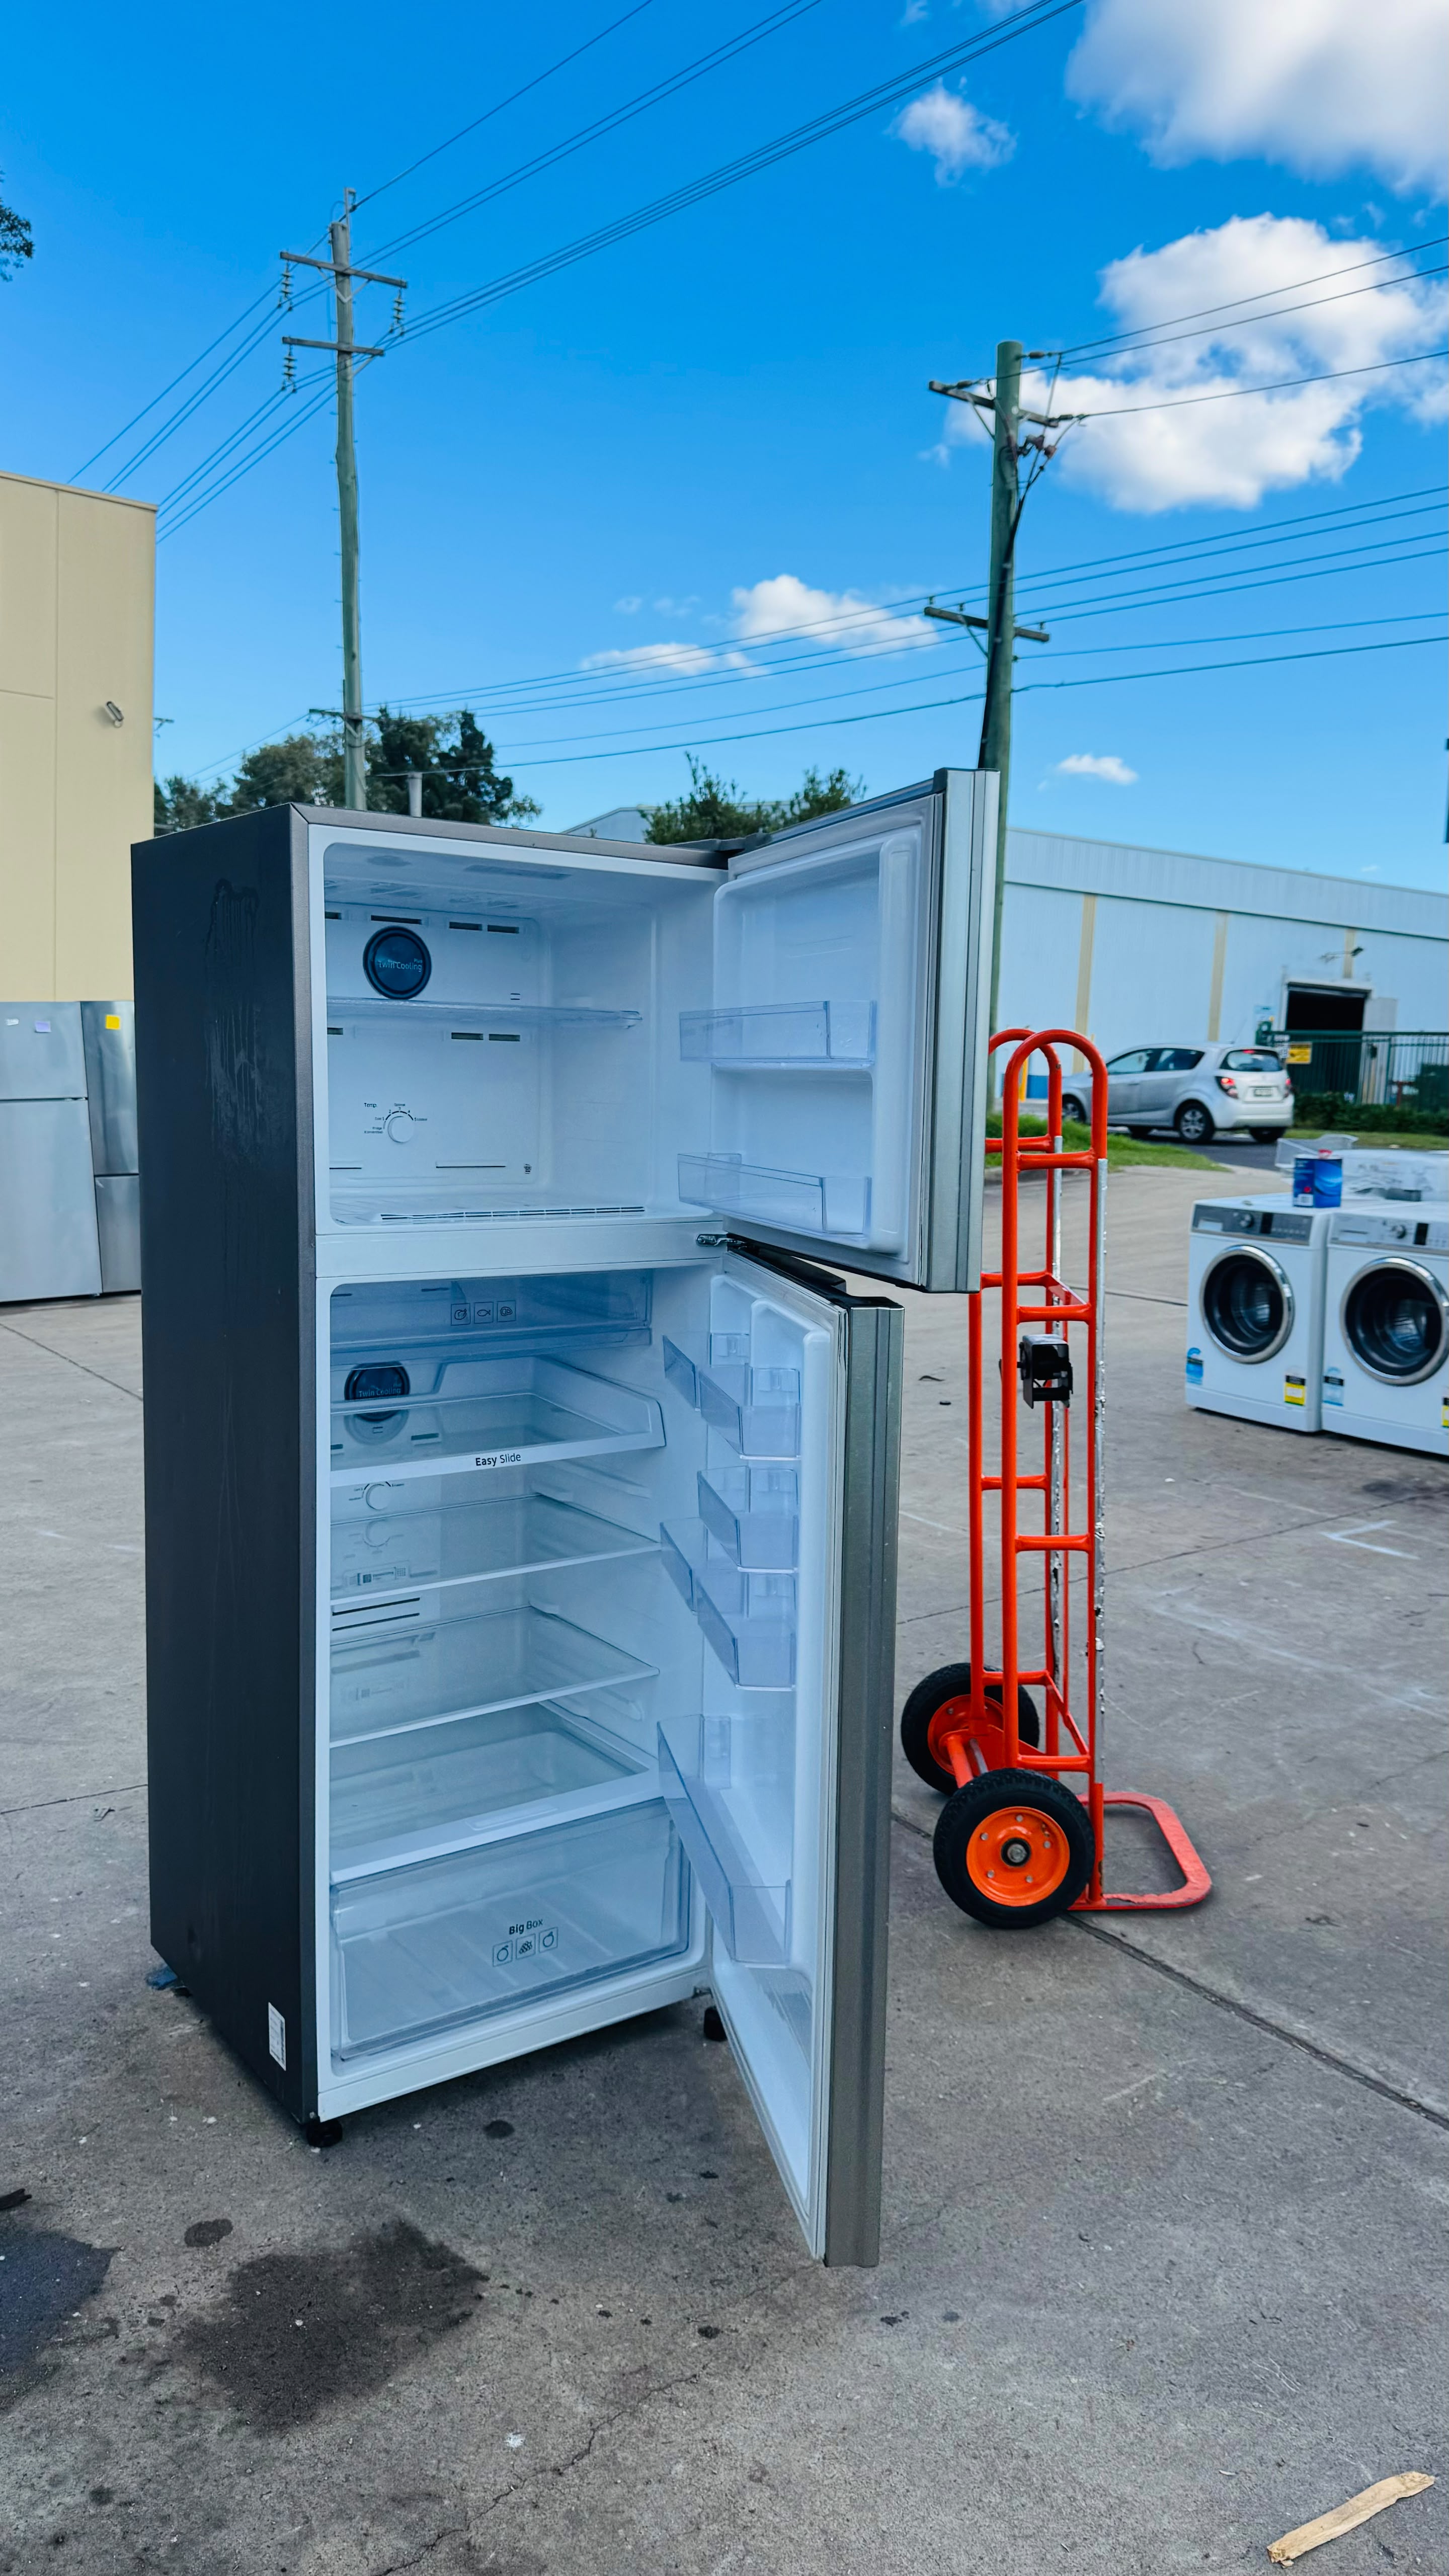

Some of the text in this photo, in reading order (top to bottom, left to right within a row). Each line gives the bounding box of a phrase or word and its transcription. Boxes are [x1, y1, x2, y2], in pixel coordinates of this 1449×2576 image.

[378, 959, 423, 972] Twin Cooling
[359, 1389, 375, 1397] Twin
[475, 1453, 521, 1467] Easy Slide
[509, 1919, 543, 1935] Big Box
